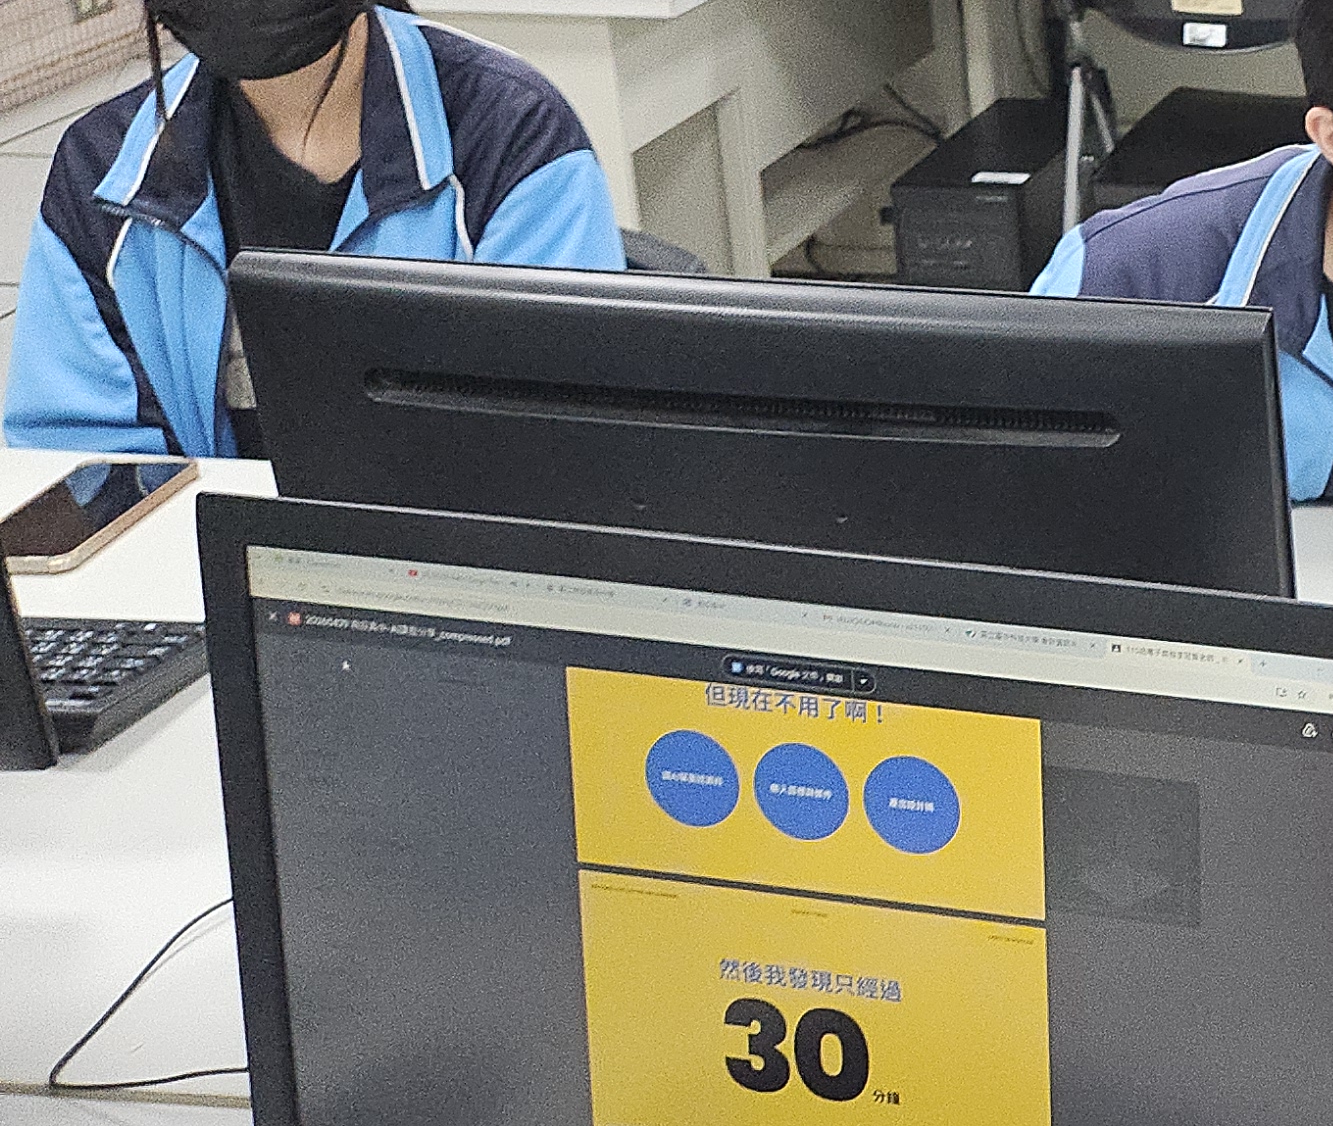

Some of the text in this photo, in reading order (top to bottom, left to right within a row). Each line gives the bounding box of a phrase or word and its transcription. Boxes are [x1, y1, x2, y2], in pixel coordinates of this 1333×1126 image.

[718, 957, 902, 1003] 然後我發現只經過
[723, 997, 870, 1102] 30
